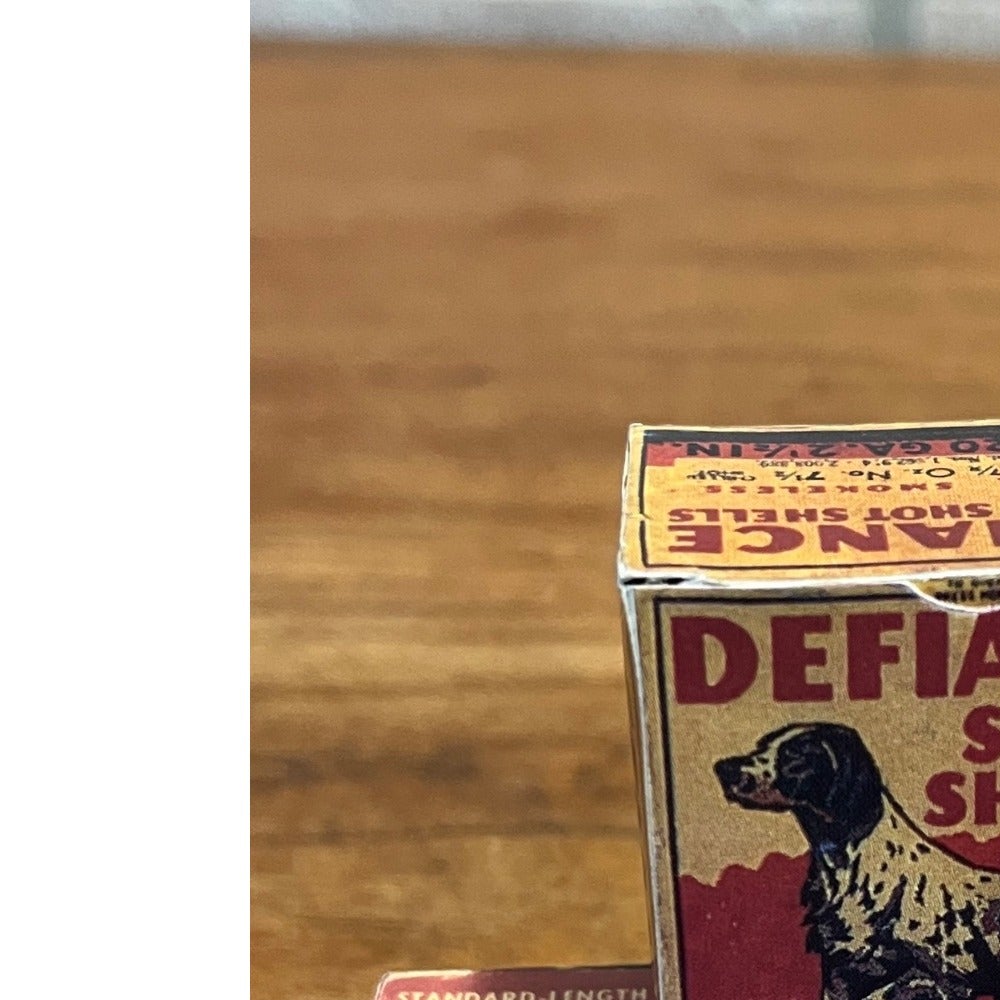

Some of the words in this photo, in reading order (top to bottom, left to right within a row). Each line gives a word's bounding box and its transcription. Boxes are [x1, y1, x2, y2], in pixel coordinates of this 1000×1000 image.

[704, 481, 953, 494] SMOKELESS
[668, 507, 849, 523] SHELLS
[864, 502, 993, 521] SHOT
